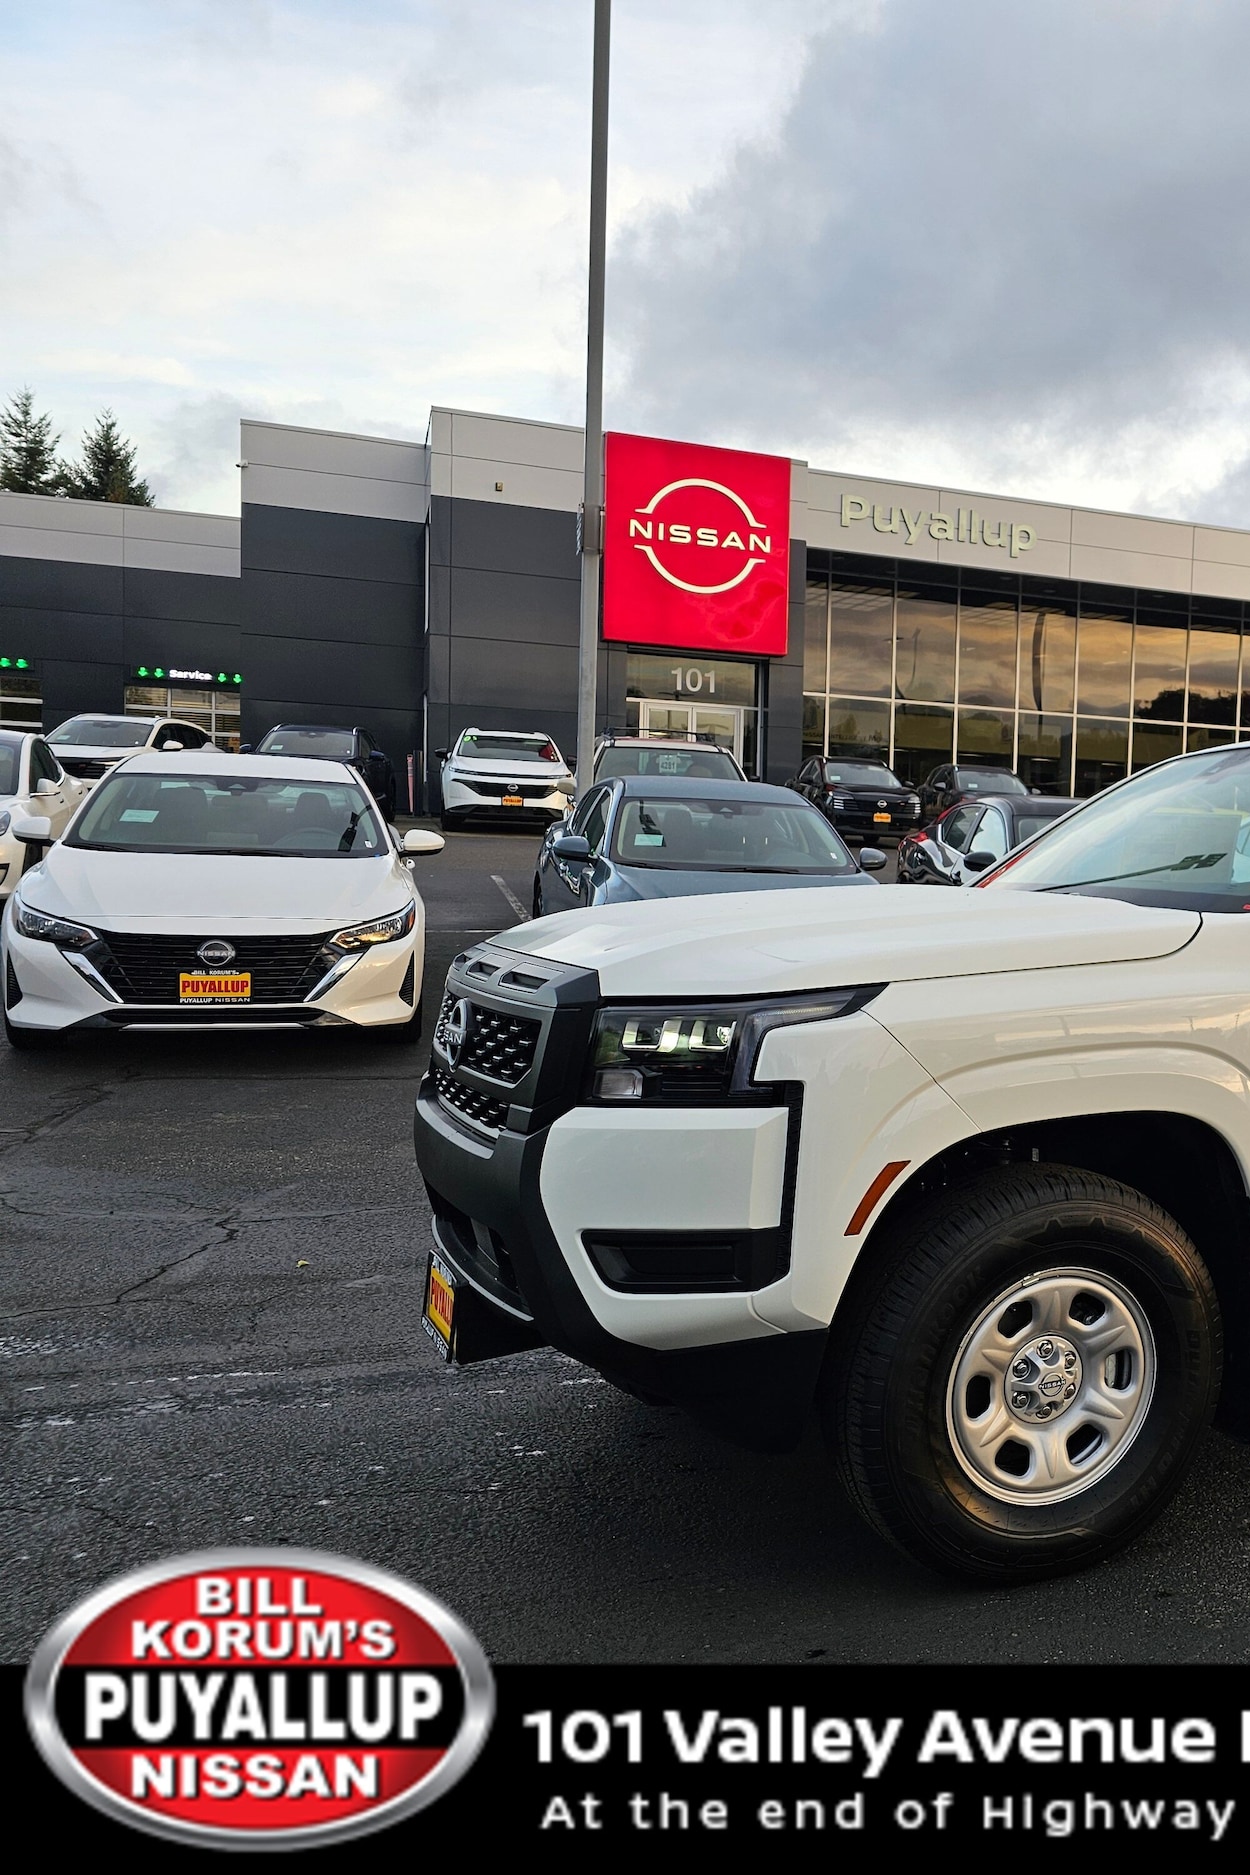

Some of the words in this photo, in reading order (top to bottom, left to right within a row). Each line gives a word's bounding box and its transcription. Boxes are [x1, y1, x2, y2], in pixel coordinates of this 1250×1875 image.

[629, 518, 771, 553] NISSAN
[840, 494, 1038, 558] Puyallup
[169, 669, 213, 681] Service
[671, 667, 715, 693] 101
[182, 980, 249, 993] PUYALLUP
[1038, 1379, 1067, 1391] NISSAN
